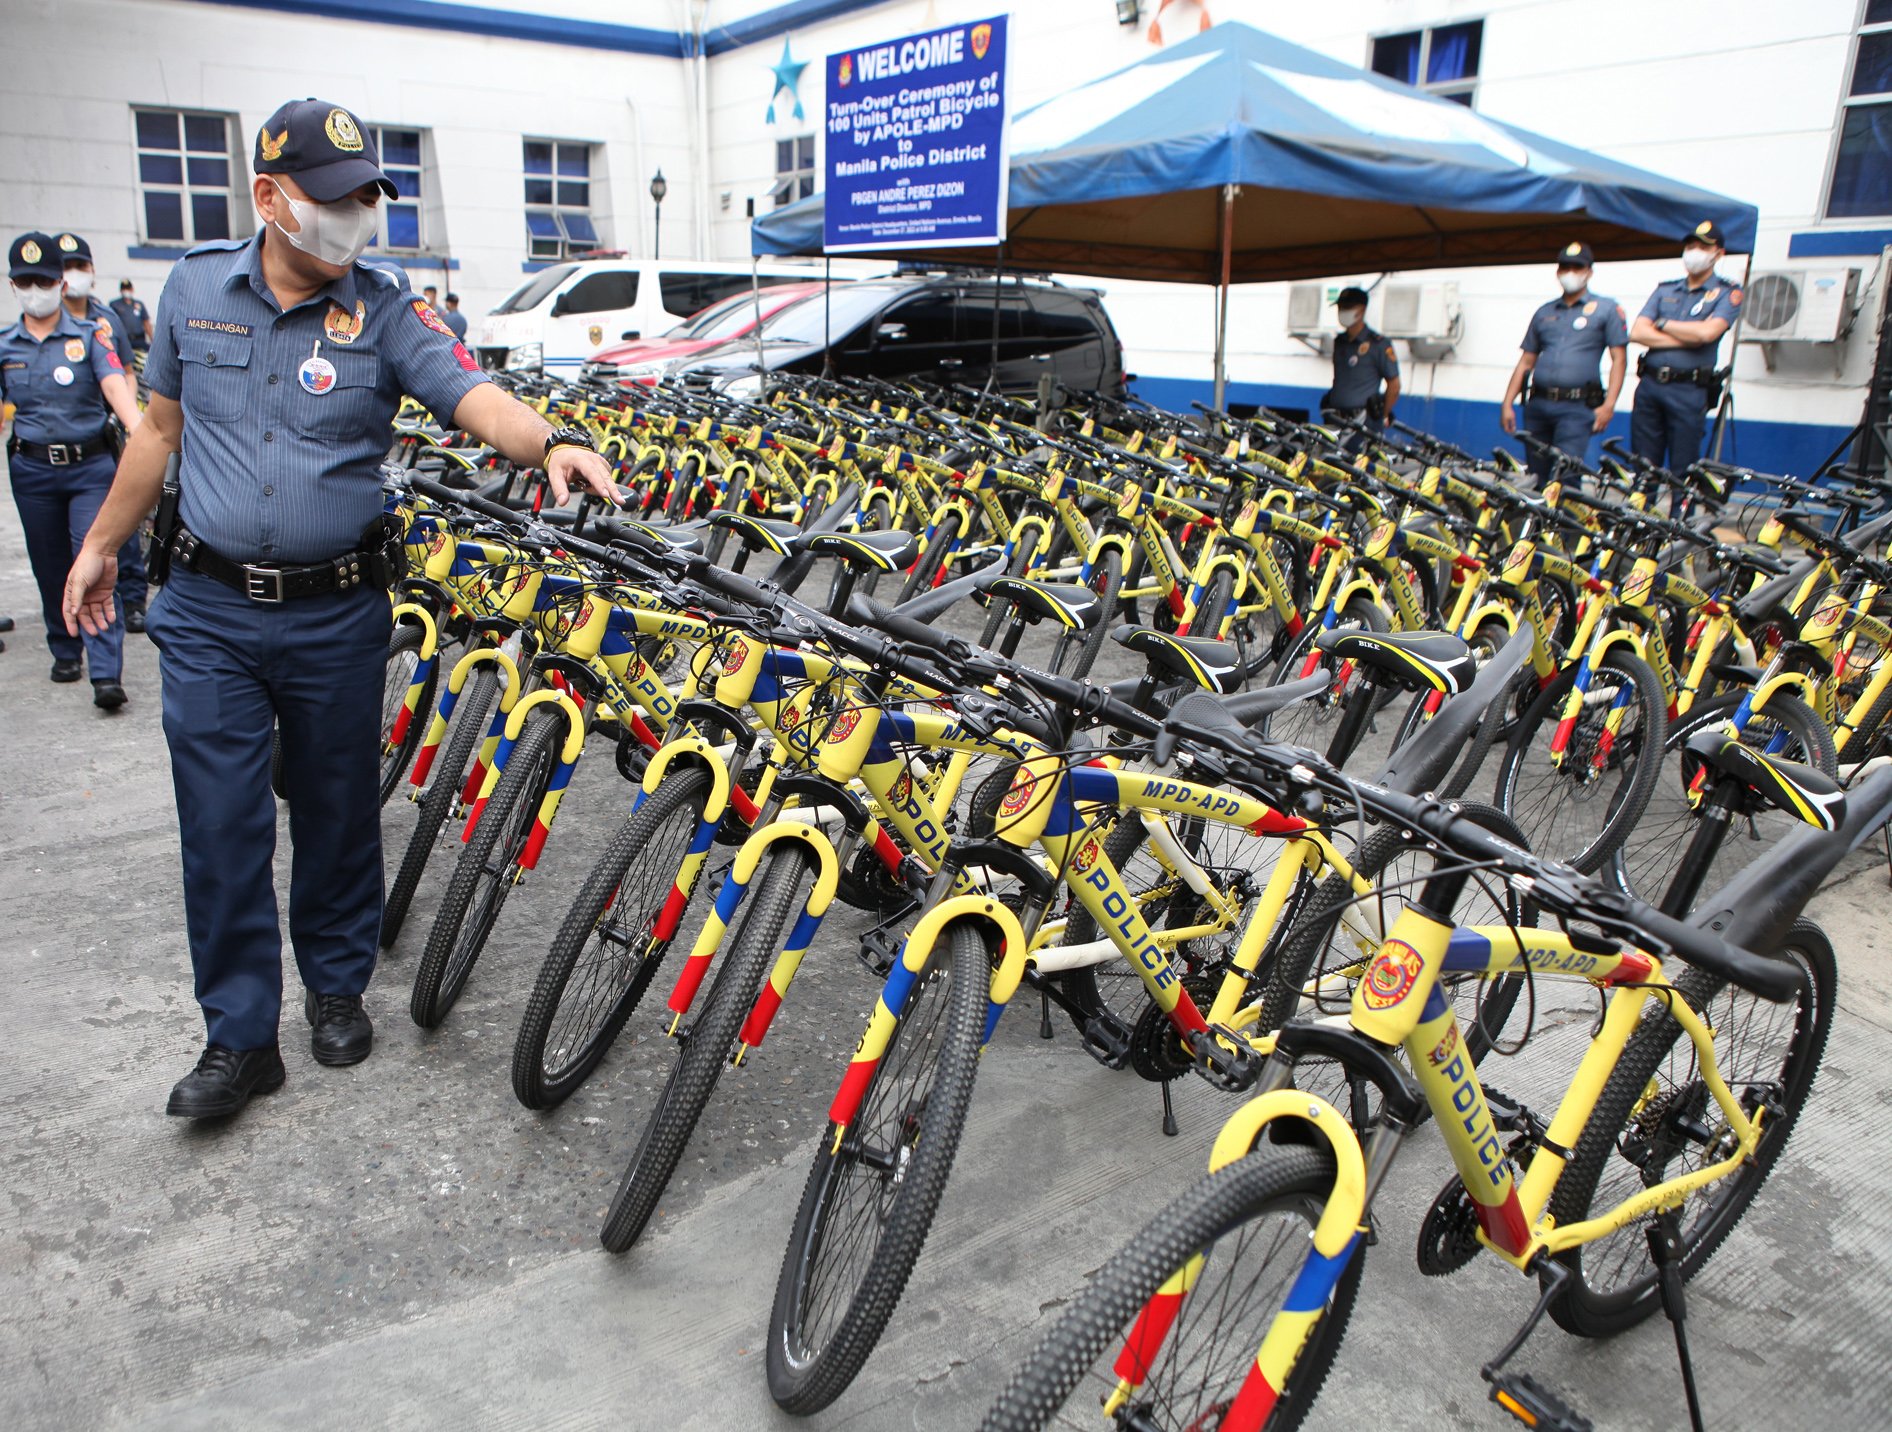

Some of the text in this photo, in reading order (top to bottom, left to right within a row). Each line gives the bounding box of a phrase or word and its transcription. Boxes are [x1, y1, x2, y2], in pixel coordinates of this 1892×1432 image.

[857, 30, 965, 83] WELCOME
[829, 72, 998, 118] Turn-Over Ceremony of
[828, 92, 1000, 133] 100 Units Patrol Bicycle
[854, 113, 964, 146] by APOLE-MPD
[897, 139, 913, 153] to
[835, 144, 987, 177] Manila Police District
[878, 187, 907, 203] ANDRE
[907, 184, 936, 200] PEREZ
[936, 181, 965, 198] DIZON
[187, 319, 249, 336] MABILANGAN
[1162, 500, 1194, 517] MPD-APD
[564, 536, 588, 548] MACCE
[1416, 538, 1452, 555] MPD-APD
[1142, 531, 1173, 583] POLICE
[1008, 582, 1027, 591] BIKE
[1265, 550, 1295, 610] POLICE
[828, 625, 860, 642] MACCE
[1147, 635, 1165, 645] BIKE
[1530, 599, 1553, 663] POLICE
[1358, 640, 1381, 651] BIKE
[1020, 665, 1057, 681] MACCE
[1142, 780, 1241, 817] MPD-APD
[1085, 867, 1176, 990] POLICE
[1441, 1054, 1509, 1186] POLICE
